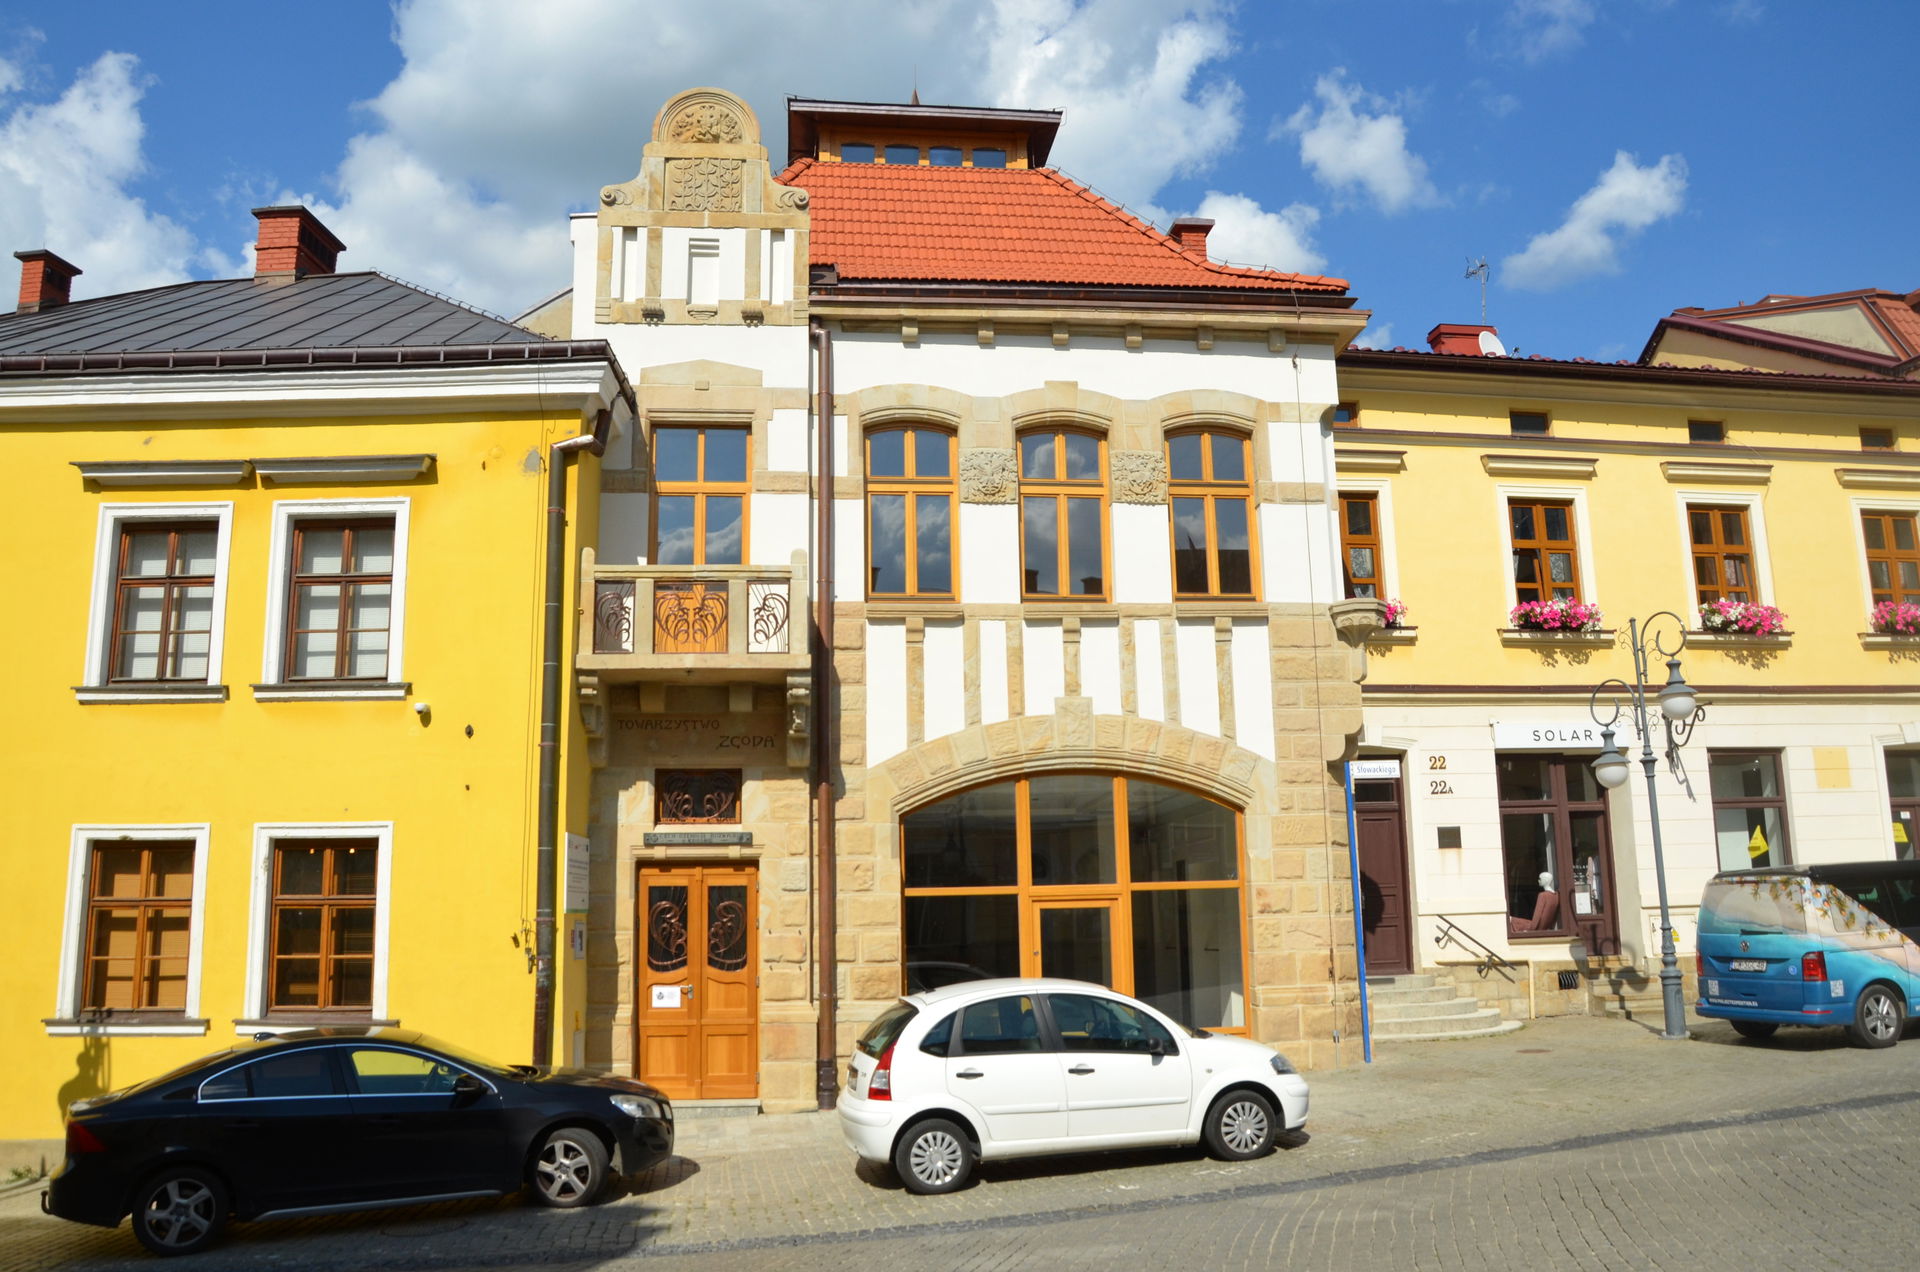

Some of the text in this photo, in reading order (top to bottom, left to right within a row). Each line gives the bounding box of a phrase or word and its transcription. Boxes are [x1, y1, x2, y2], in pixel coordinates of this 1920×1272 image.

[616, 719, 720, 732] TOWARZYSTWO
[1533, 729, 1593, 742] SOLAR
[1429, 755, 1447, 770] 22
[1430, 780, 1454, 795] 22A
